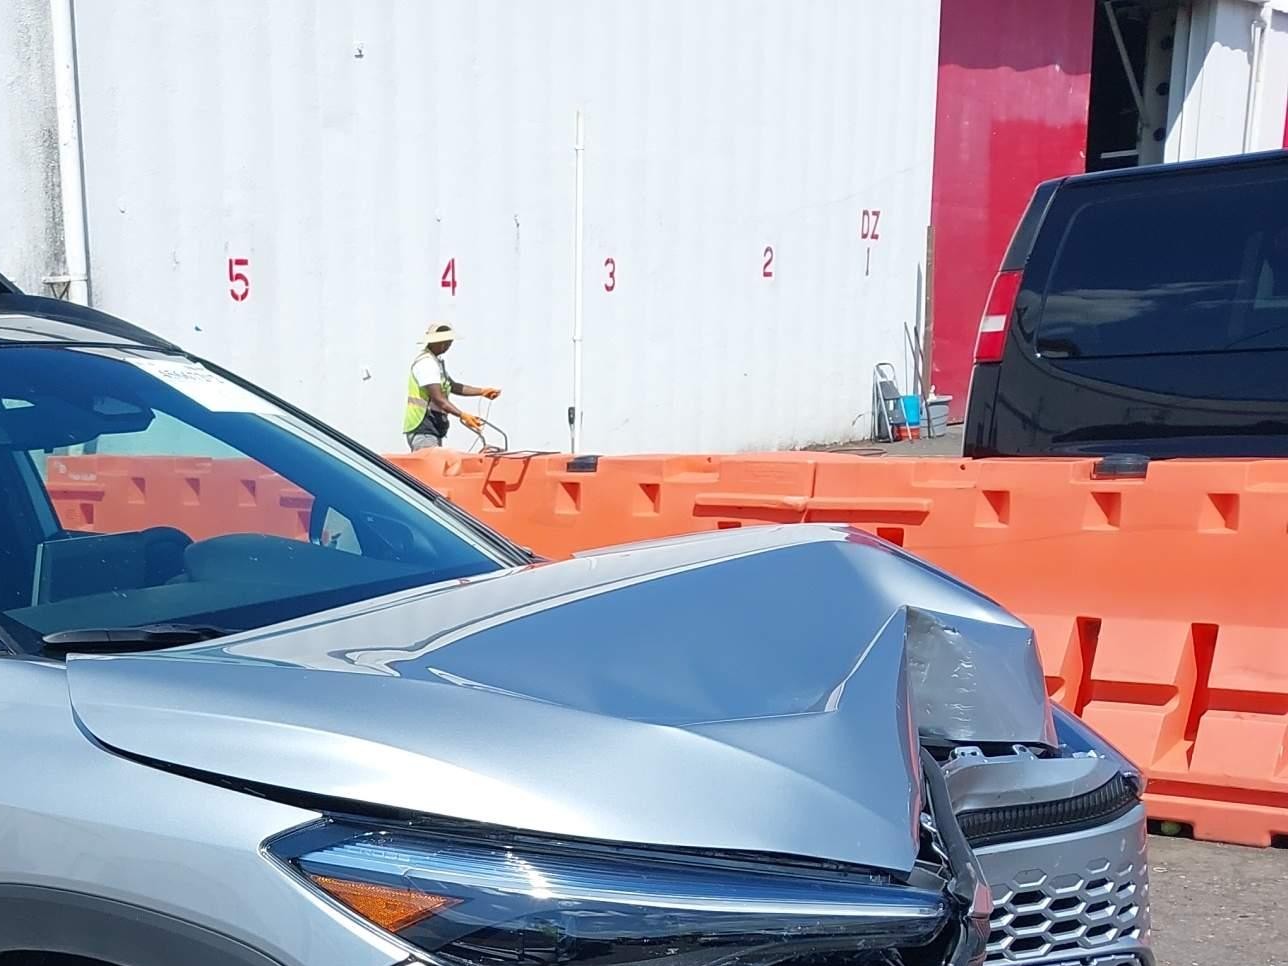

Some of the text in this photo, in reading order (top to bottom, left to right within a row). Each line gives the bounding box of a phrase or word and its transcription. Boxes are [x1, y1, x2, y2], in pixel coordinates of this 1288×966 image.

[861, 210, 880, 240] DZ
[441, 258, 456, 296] 4
[604, 257, 615, 292] 3
[763, 246, 773, 277] 2
[228, 258, 249, 302] 5
